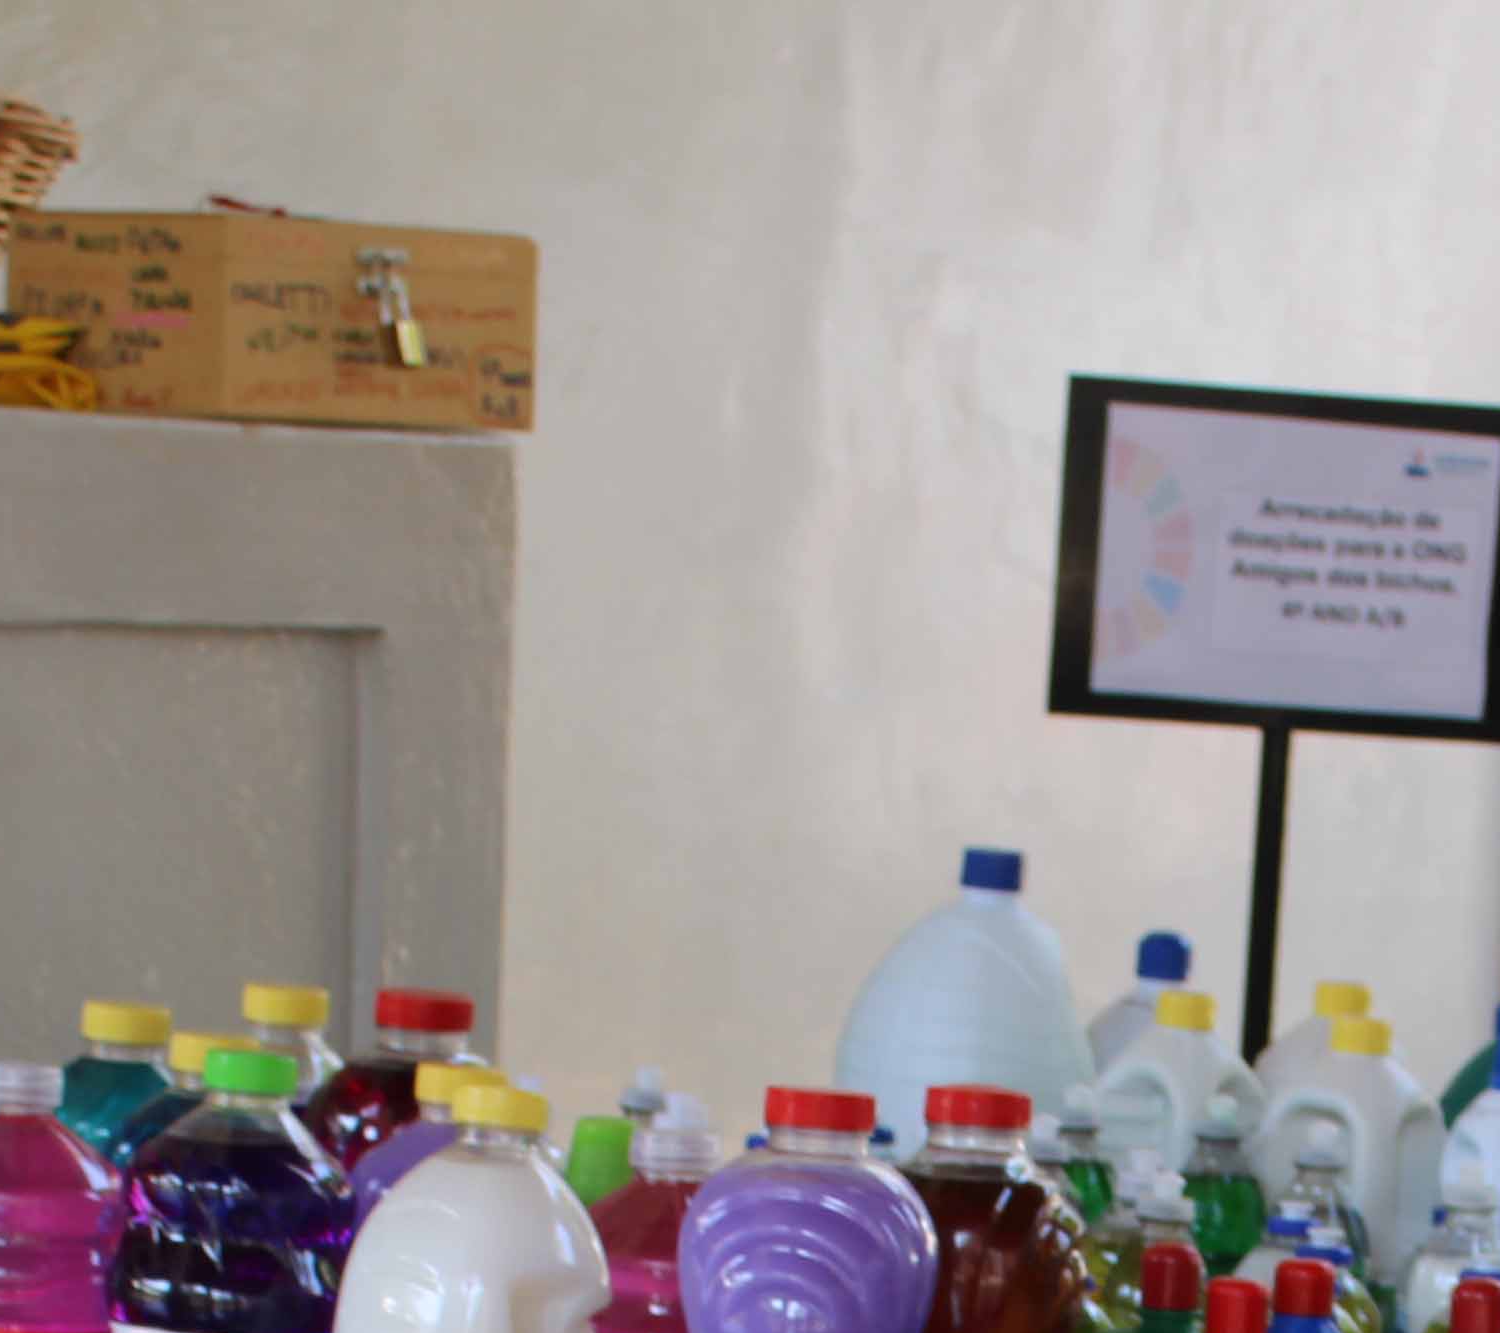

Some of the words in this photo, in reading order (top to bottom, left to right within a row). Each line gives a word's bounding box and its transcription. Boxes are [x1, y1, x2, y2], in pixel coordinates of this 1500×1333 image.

[1414, 510, 1442, 529] de
[1335, 540, 1385, 560] para
[1232, 559, 1318, 586] Amigos
